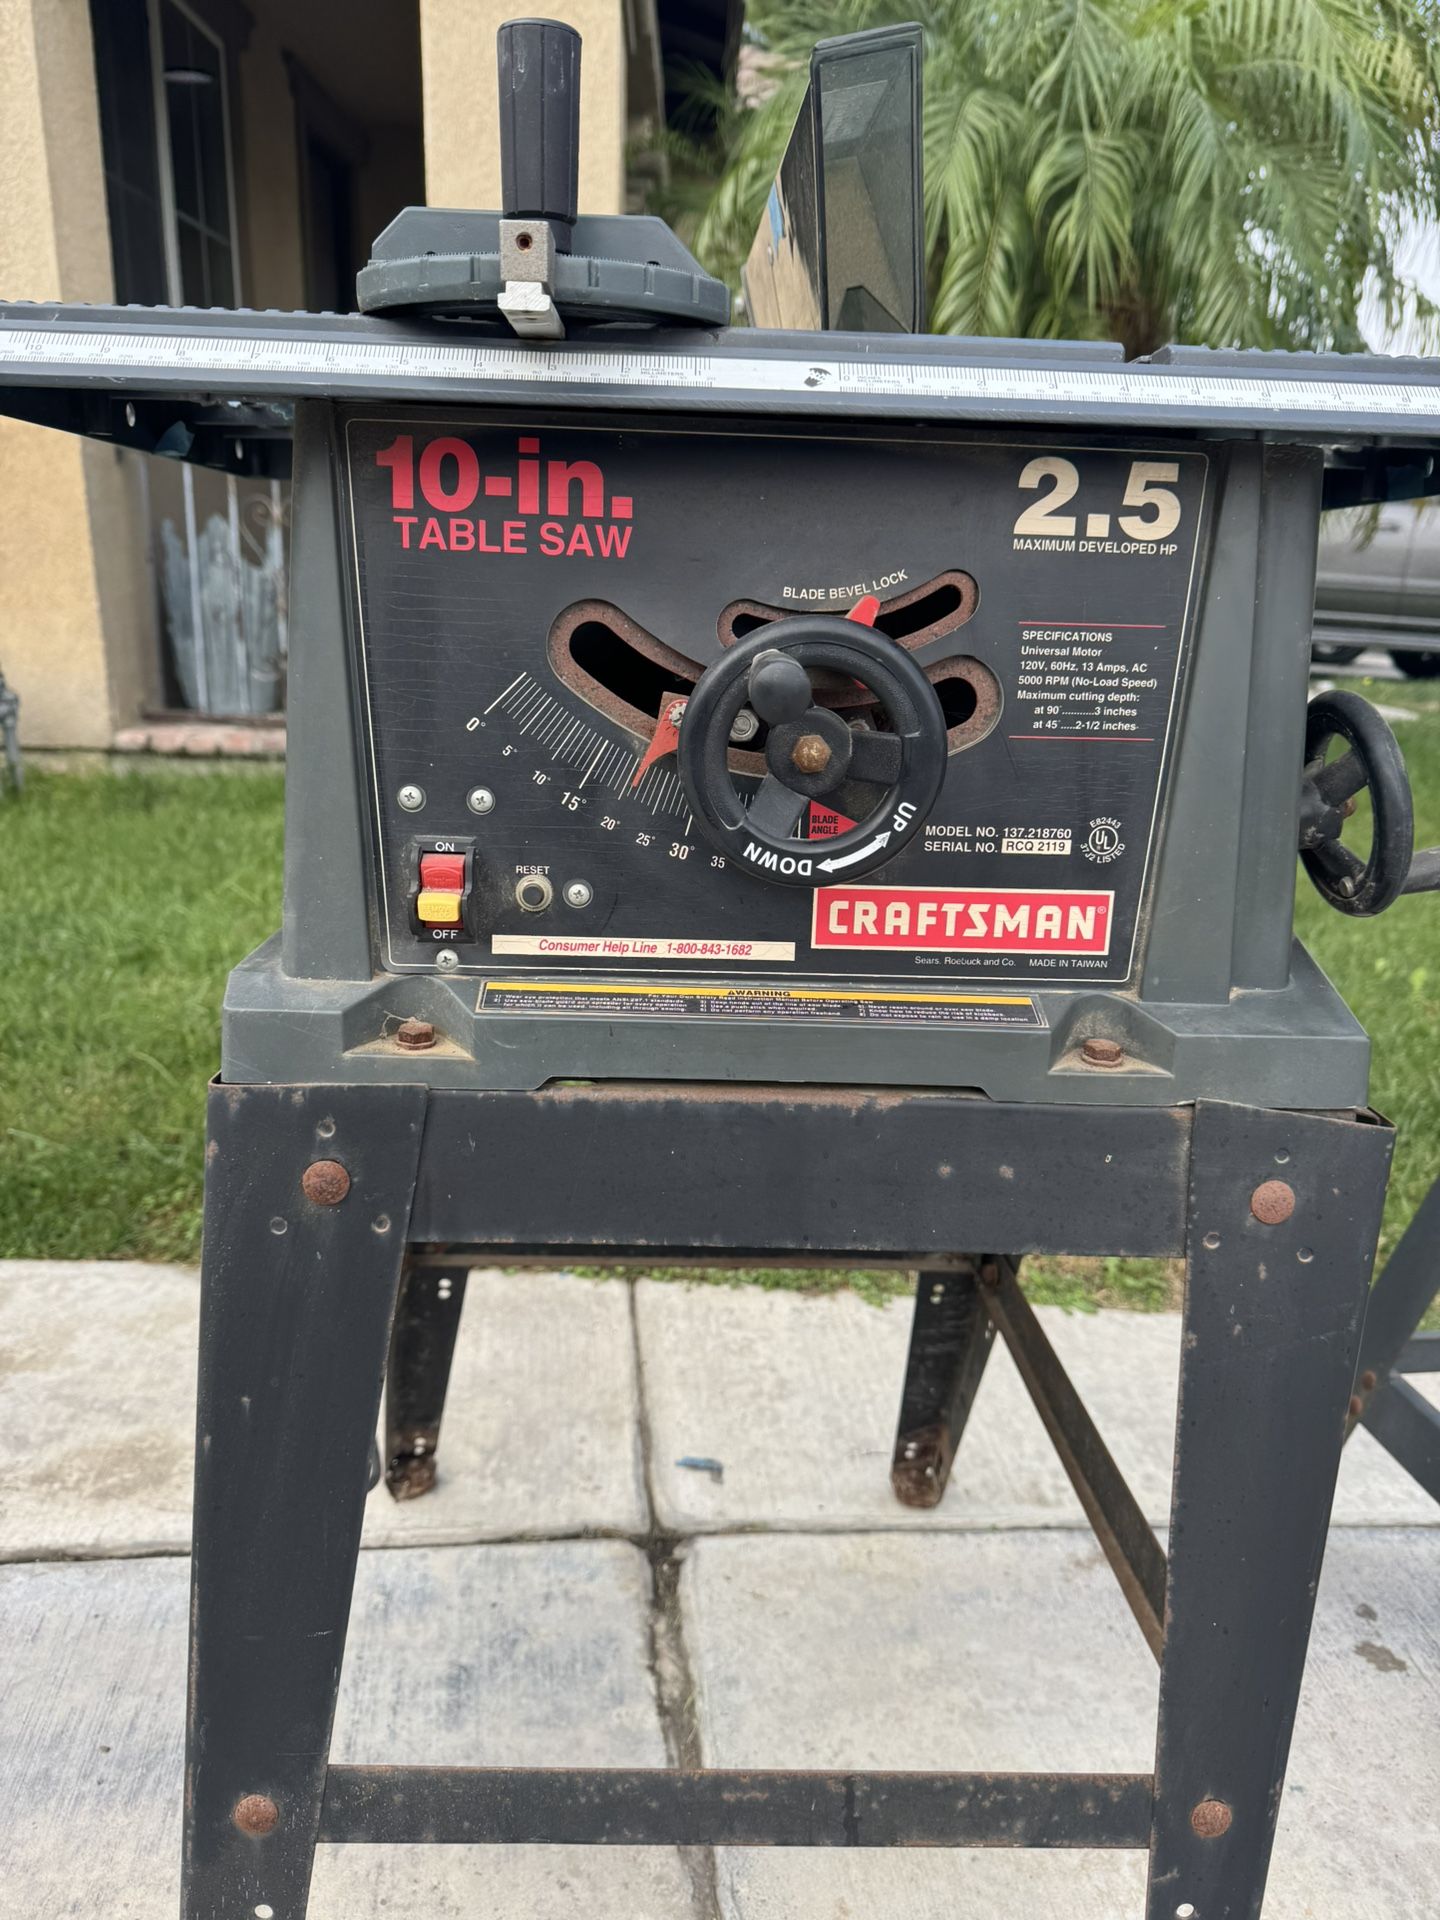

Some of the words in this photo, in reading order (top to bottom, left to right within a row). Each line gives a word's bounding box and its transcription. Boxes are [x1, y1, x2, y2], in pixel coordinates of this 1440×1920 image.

[376, 434, 633, 519] 10-in.
[1013, 456, 1181, 541] 2.5
[393, 516, 528, 555] TABLE
[540, 522, 633, 559] SAW
[1013, 538, 1076, 553] MAXIMUM
[1079, 540, 1158, 555] DEVELOPED
[1160, 543, 1178, 556] HP
[782, 586, 826, 600] BLADE
[829, 583, 871, 599] BEVEL
[872, 568, 908, 592] LOCK
[1022, 630, 1113, 642] SPECIFICATIONS
[1021, 645, 1069, 656] Universal
[1072, 647, 1102, 657] Motor
[1020, 661, 1048, 672] 120V,
[1050, 661, 1078, 672] 60Hz,
[1082, 662, 1094, 672] 13
[1096, 662, 1129, 675] Amps,
[1131, 663, 1148, 673] AC
[1018, 675, 1043, 685] 5000
[1045, 676, 1069, 686] RPM
[1071, 676, 1119, 688] (No-Load
[1121, 678, 1157, 690] Speed)
[1017, 690, 1067, 701] Maximum
[1069, 692, 1105, 703] cutting
[1107, 693, 1140, 704] depth:
[1034, 705, 1044, 715] at
[1103, 706, 1137, 717] inches
[1032, 720, 1043, 729] at
[1102, 721, 1137, 732] inches
[812, 814, 839, 825] BLADE
[893, 802, 917, 832] UP
[1089, 816, 1122, 830] E82443
[811, 825, 839, 837] ANGLE
[925, 825, 972, 838] MODEL
[976, 826, 999, 839] NO.
[1002, 827, 1072, 839] 137.218760
[435, 841, 455, 852] ON
[924, 841, 971, 853] SERIAL
[975, 842, 999, 853] NO.
[1006, 841, 1034, 853] RCQ
[1037, 841, 1065, 853] 2119
[1096, 843, 1126, 864] LISTED
[710, 855, 727, 869] 35
[743, 842, 812, 876] DOWN
[515, 866, 550, 878] RESET
[432, 931, 458, 941] OFF
[539, 938, 600, 953] Consumer
[602, 942, 629, 955] Help
[632, 942, 658, 954] Line
[667, 943, 752, 956] 1-800-843-1682
[944, 957, 981, 966] Roebuck
[983, 958, 1000, 966] and
[1001, 959, 1016, 967] Co.
[1029, 959, 1057, 967] MADE
[1059, 960, 1069, 968] IN
[1071, 960, 1108, 969] TAIWAN
